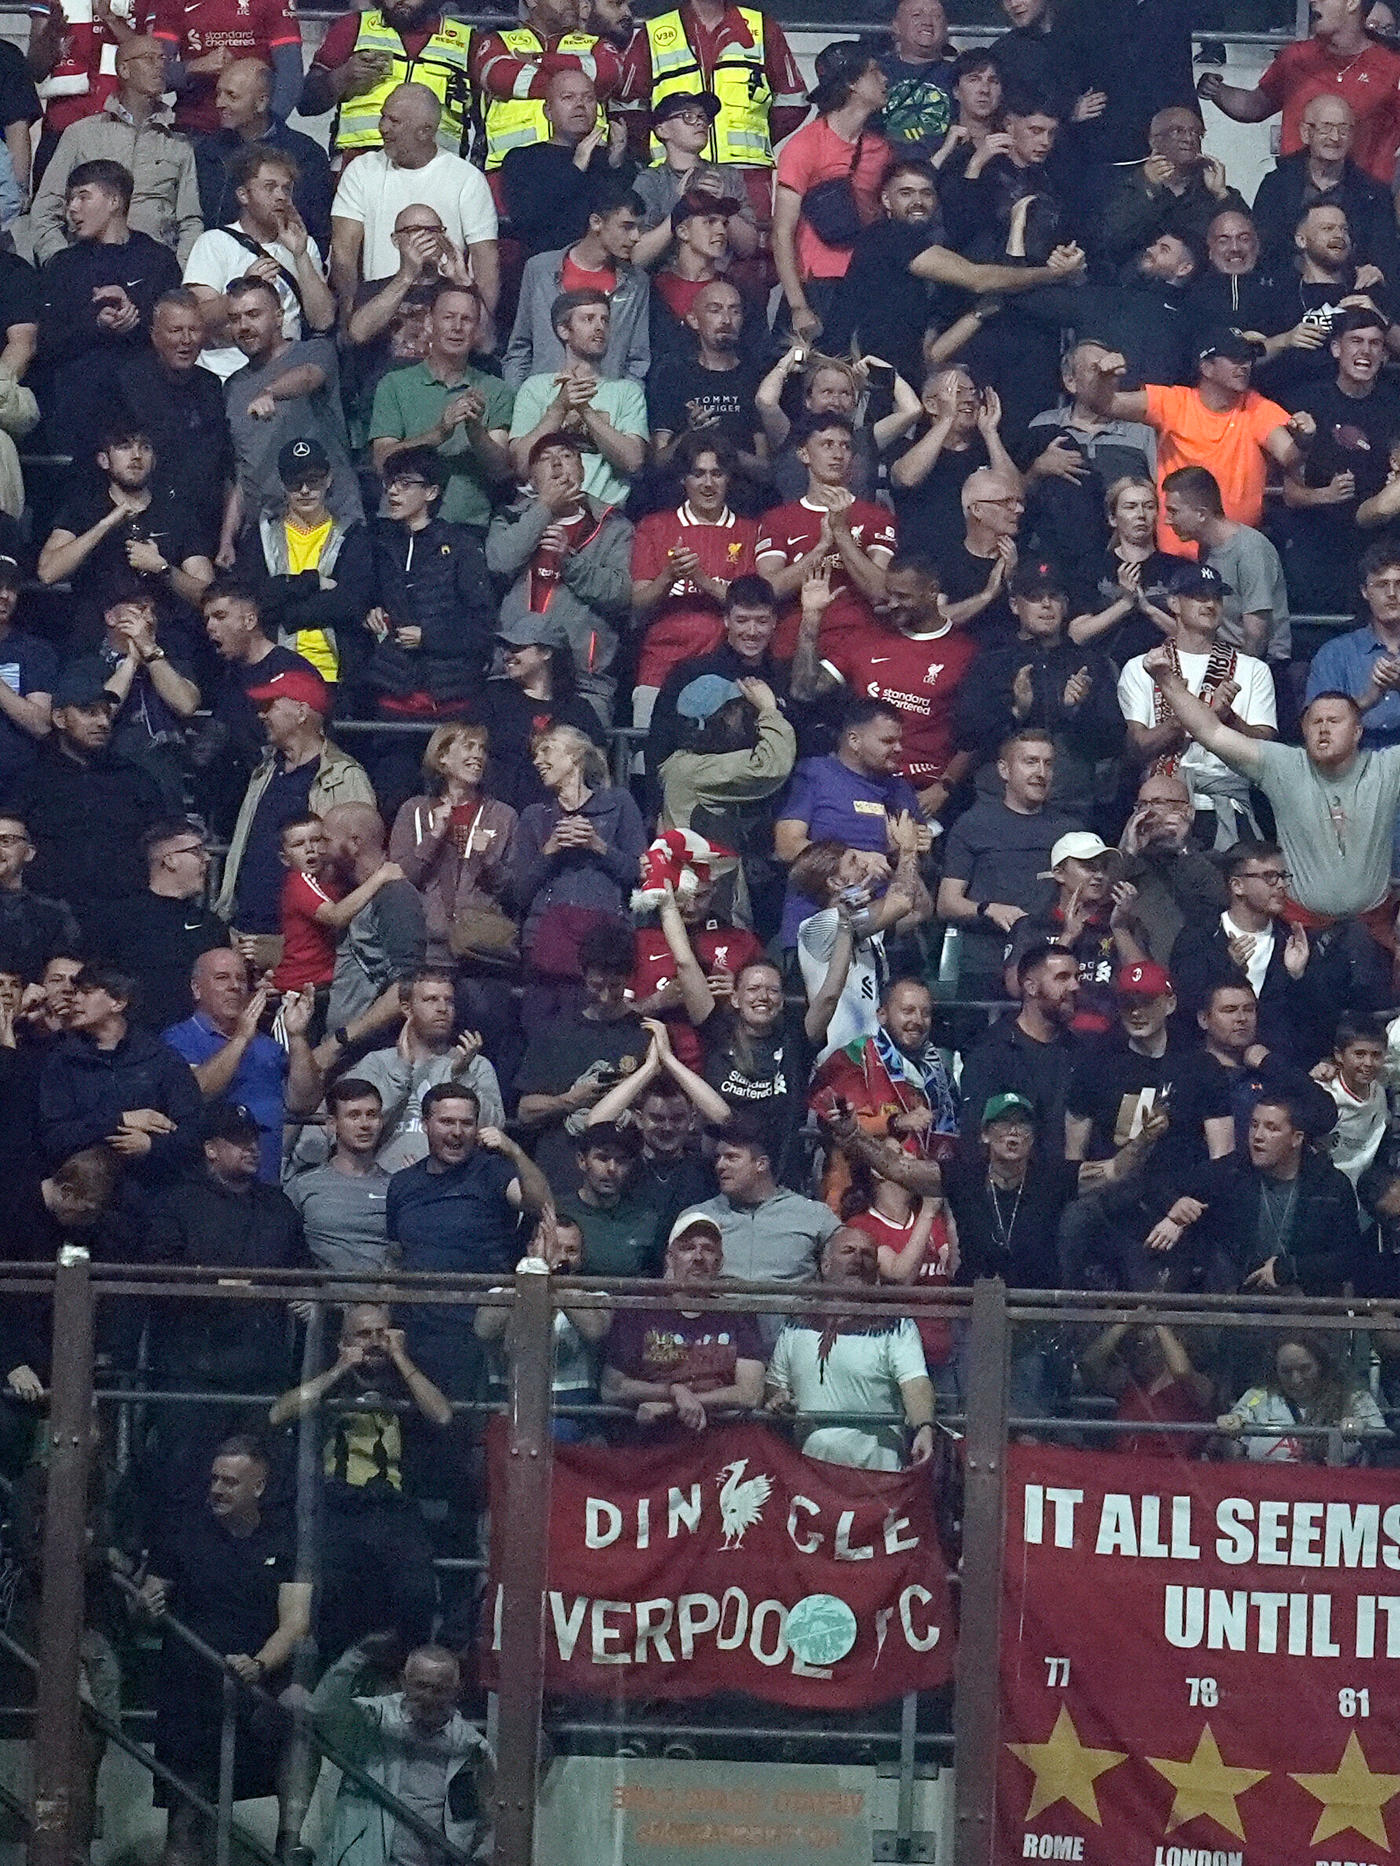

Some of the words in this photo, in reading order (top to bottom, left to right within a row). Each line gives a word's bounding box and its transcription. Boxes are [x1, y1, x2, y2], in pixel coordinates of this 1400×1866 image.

[205, 30, 253, 40] standard
[205, 37, 255, 47] chartered
[695, 396, 738, 404] TOMMY
[883, 688, 931, 706] standard
[720, 1080, 773, 1099] Chartered
[729, 1070, 771, 1089] Standar
[1024, 1484, 1083, 1549] IT
[1095, 1493, 1200, 1560] ALL
[1165, 1584, 1341, 1658] UNTIL
[1044, 1656, 1071, 1687] 77
[1185, 1677, 1219, 1707] 78
[1338, 1687, 1370, 1717] 81
[1022, 1833, 1085, 1862] ROME
[1154, 1845, 1243, 1866] LONDON
